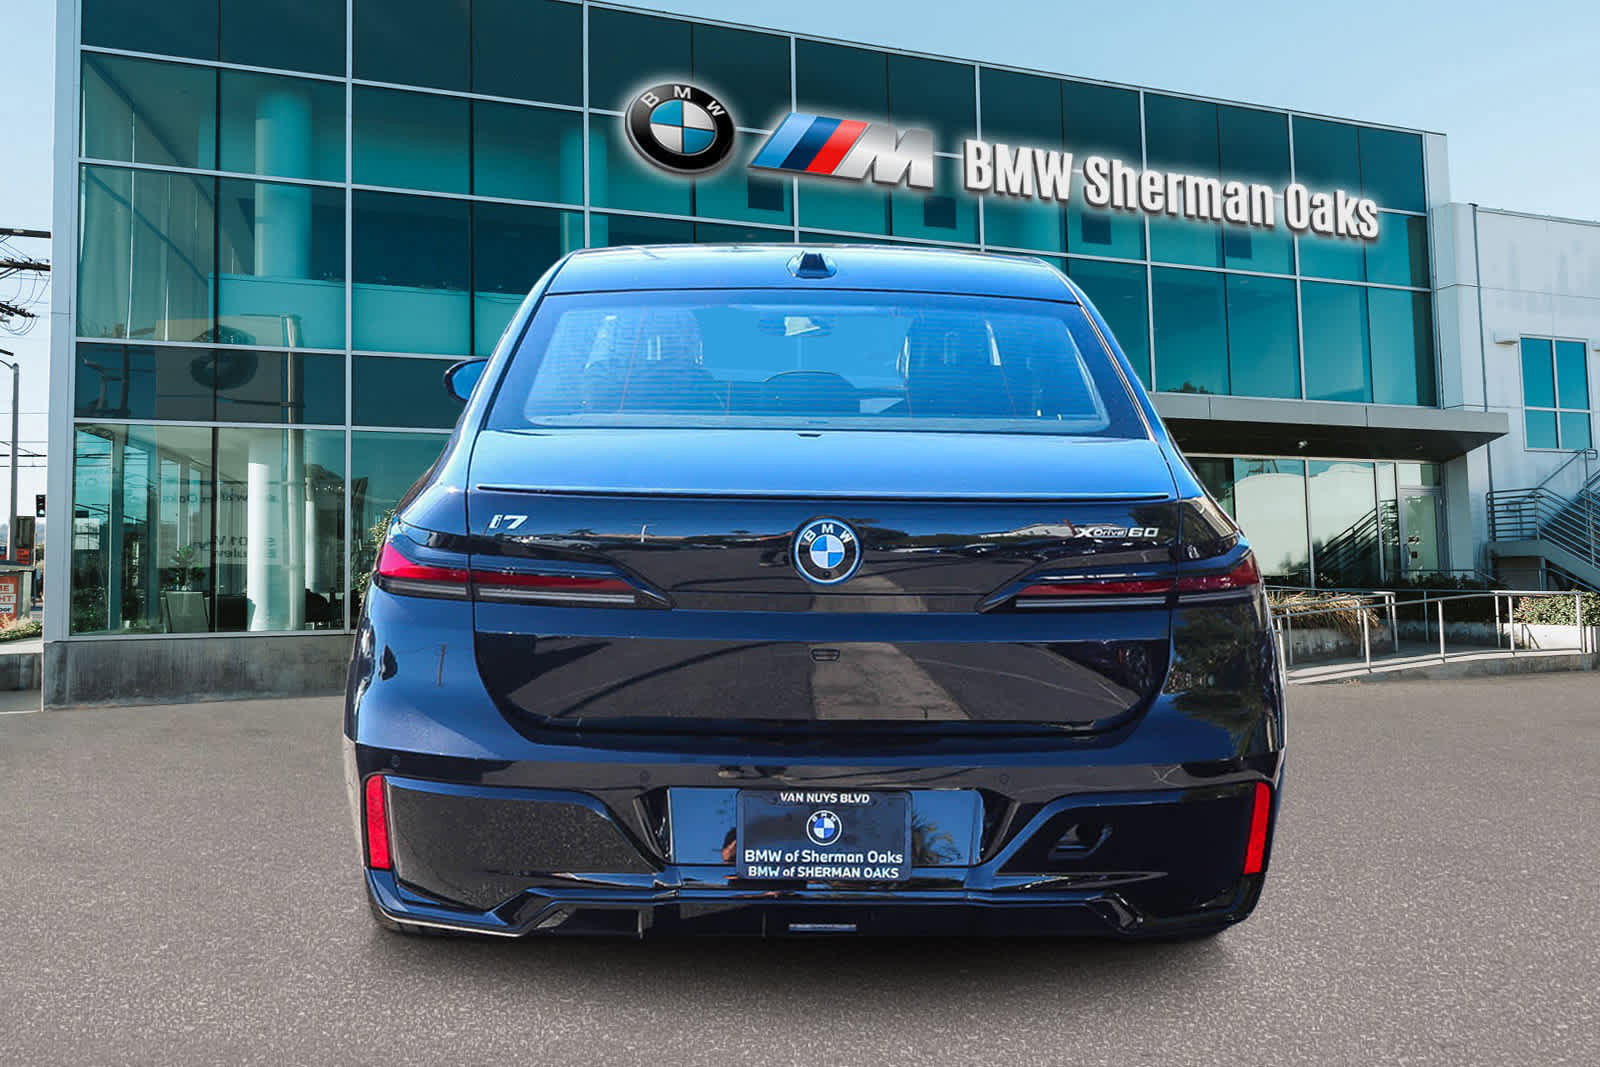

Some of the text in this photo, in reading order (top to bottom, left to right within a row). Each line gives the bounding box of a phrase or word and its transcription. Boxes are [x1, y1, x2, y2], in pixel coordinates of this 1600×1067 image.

[641, 84, 726, 118] BMW
[963, 138, 1380, 242] BMW Sherman Oaks
[803, 523, 854, 544] BMW
[780, 792, 871, 804] VAN NUYS BLVD
[744, 849, 904, 864] BMW of Sherman Oaks
[748, 866, 900, 878] BMW of SHERMAN OAKS
